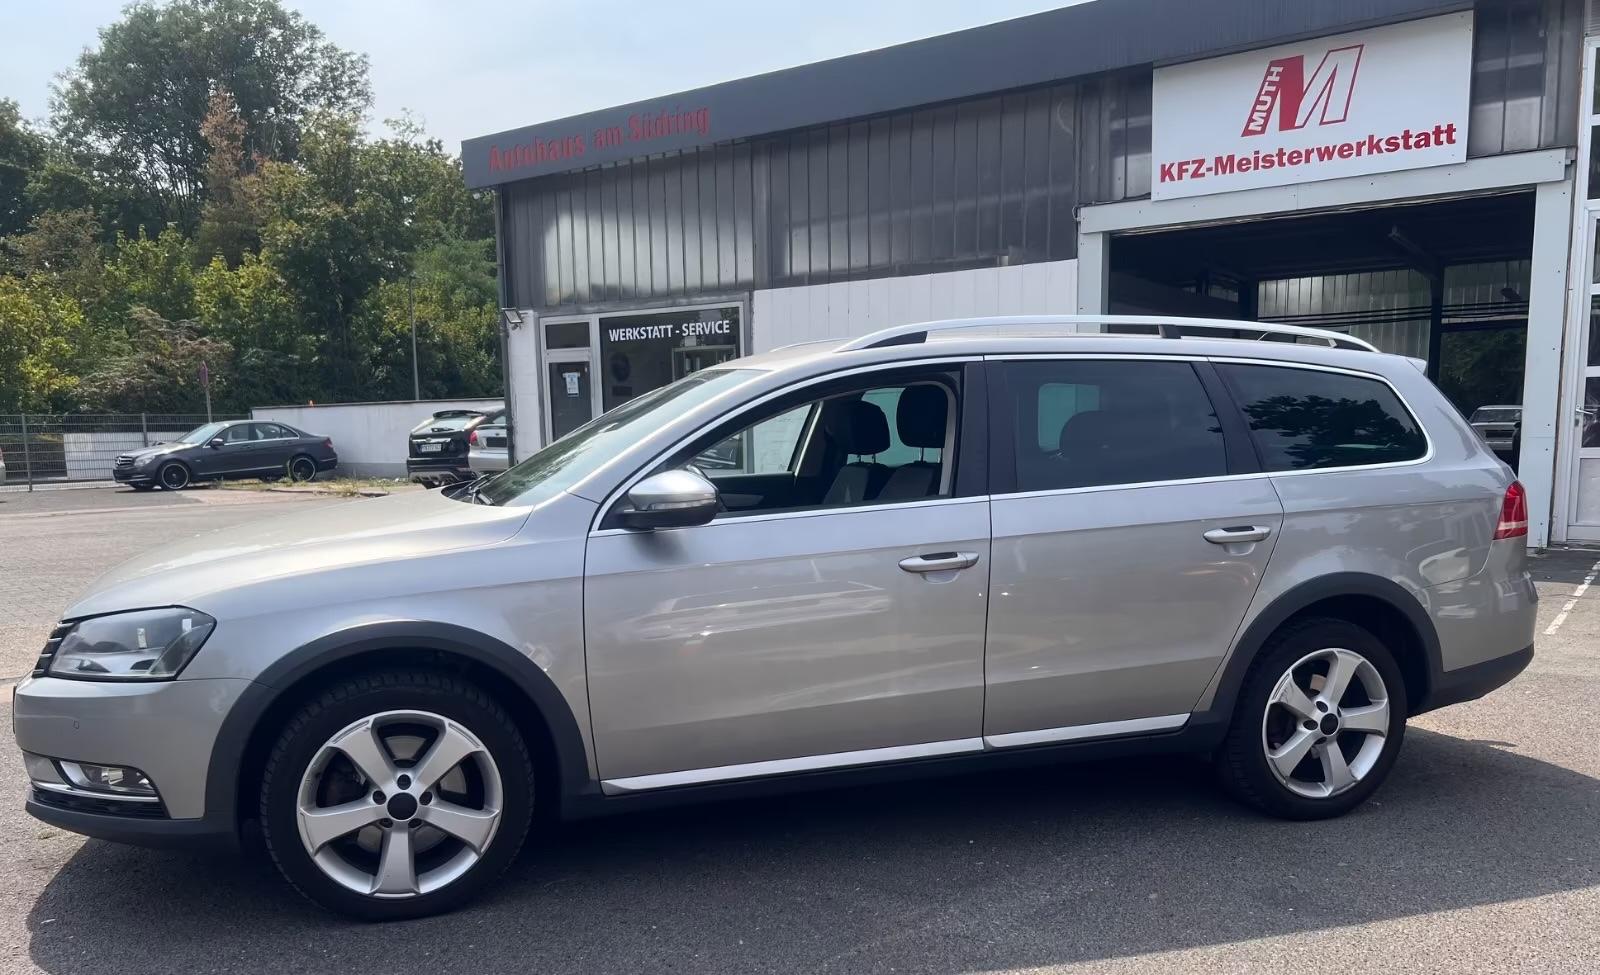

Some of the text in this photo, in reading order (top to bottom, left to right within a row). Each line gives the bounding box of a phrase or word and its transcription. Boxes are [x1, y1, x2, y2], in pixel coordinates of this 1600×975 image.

[1248, 66, 1284, 131] MUTH
[489, 105, 711, 171] Autohaus am Südring
[1160, 123, 1457, 182] KFZ-Meisterwerkstatt
[609, 324, 673, 342] WERKSTATT
[682, 320, 730, 337] SERVICE
